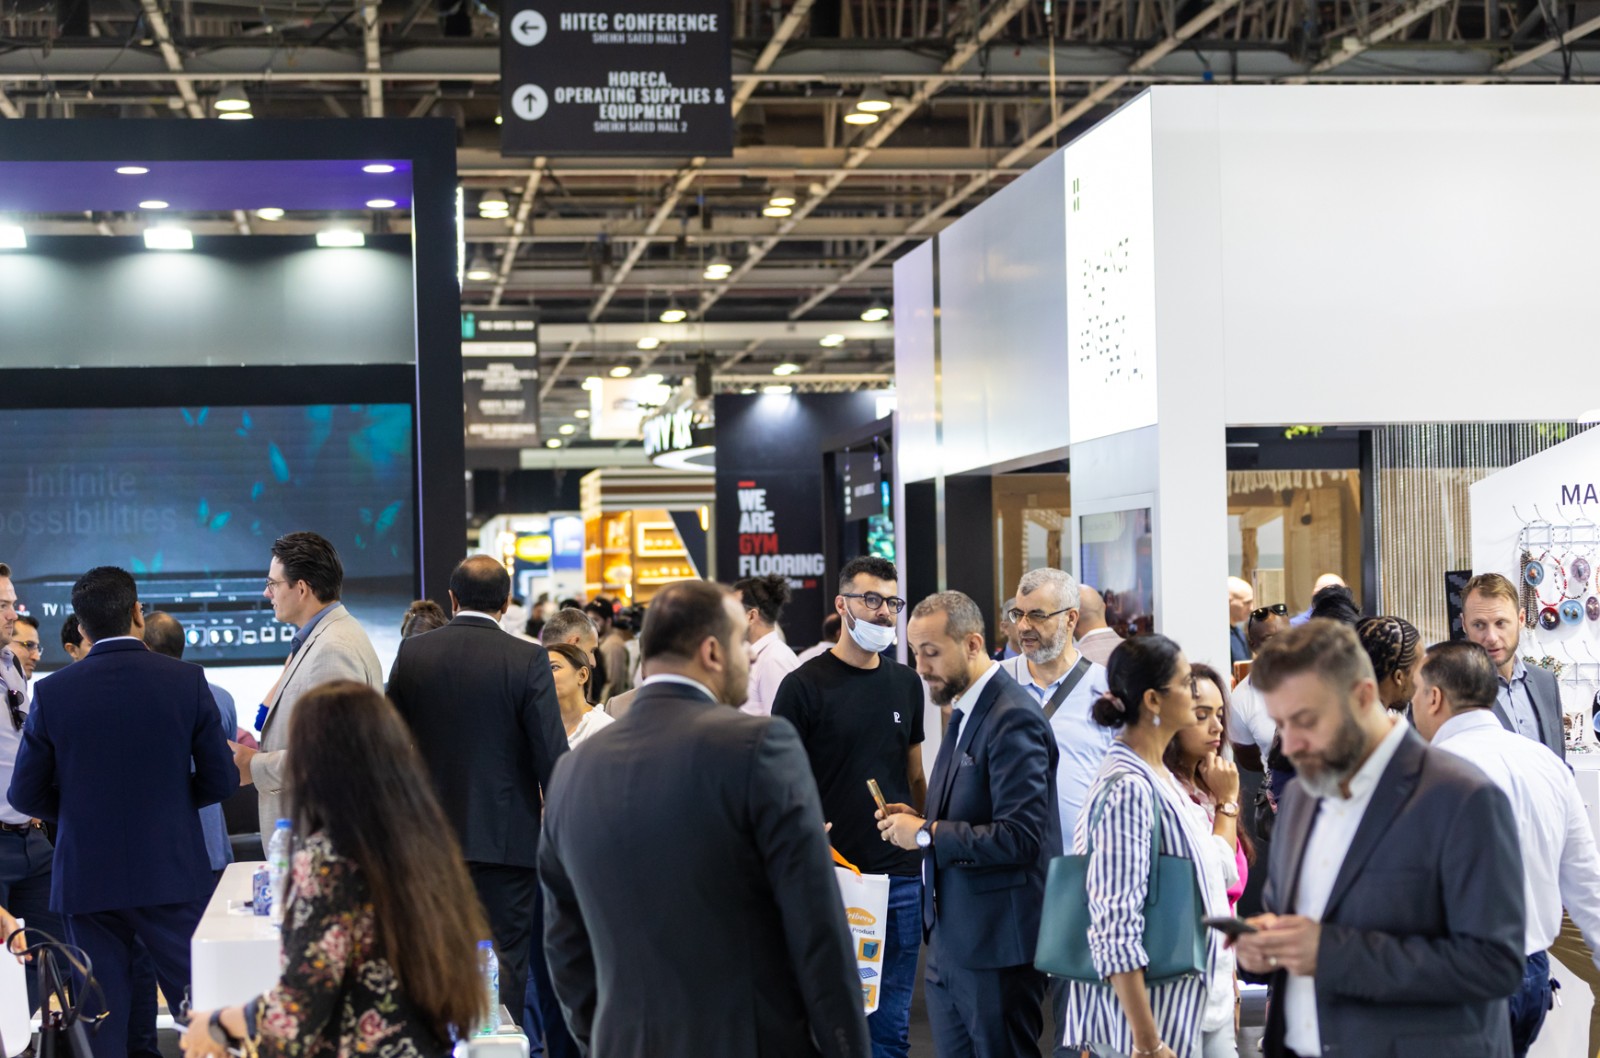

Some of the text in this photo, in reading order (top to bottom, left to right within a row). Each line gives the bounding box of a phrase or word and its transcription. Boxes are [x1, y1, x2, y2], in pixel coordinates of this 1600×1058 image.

[560, 13, 718, 32] HITEC CONFERENCE
[592, 33, 687, 44] SHEIKH SAEED HALL 3
[608, 71, 672, 88] HORECA,
[554, 87, 726, 104] OPERATING SUPPLIES &
[599, 104, 682, 120] EQUIPMENT
[593, 121, 688, 132] SHEIKH SAEED HALL 2
[26, 464, 137, 497] Infinite
[737, 489, 767, 511] WE
[0, 500, 178, 536] ossibilities
[739, 511, 775, 533] ARE
[739, 533, 779, 554] GYM
[739, 554, 825, 577] FLOORING
[41, 602, 58, 617] TV
[852, 927, 875, 936] Product
